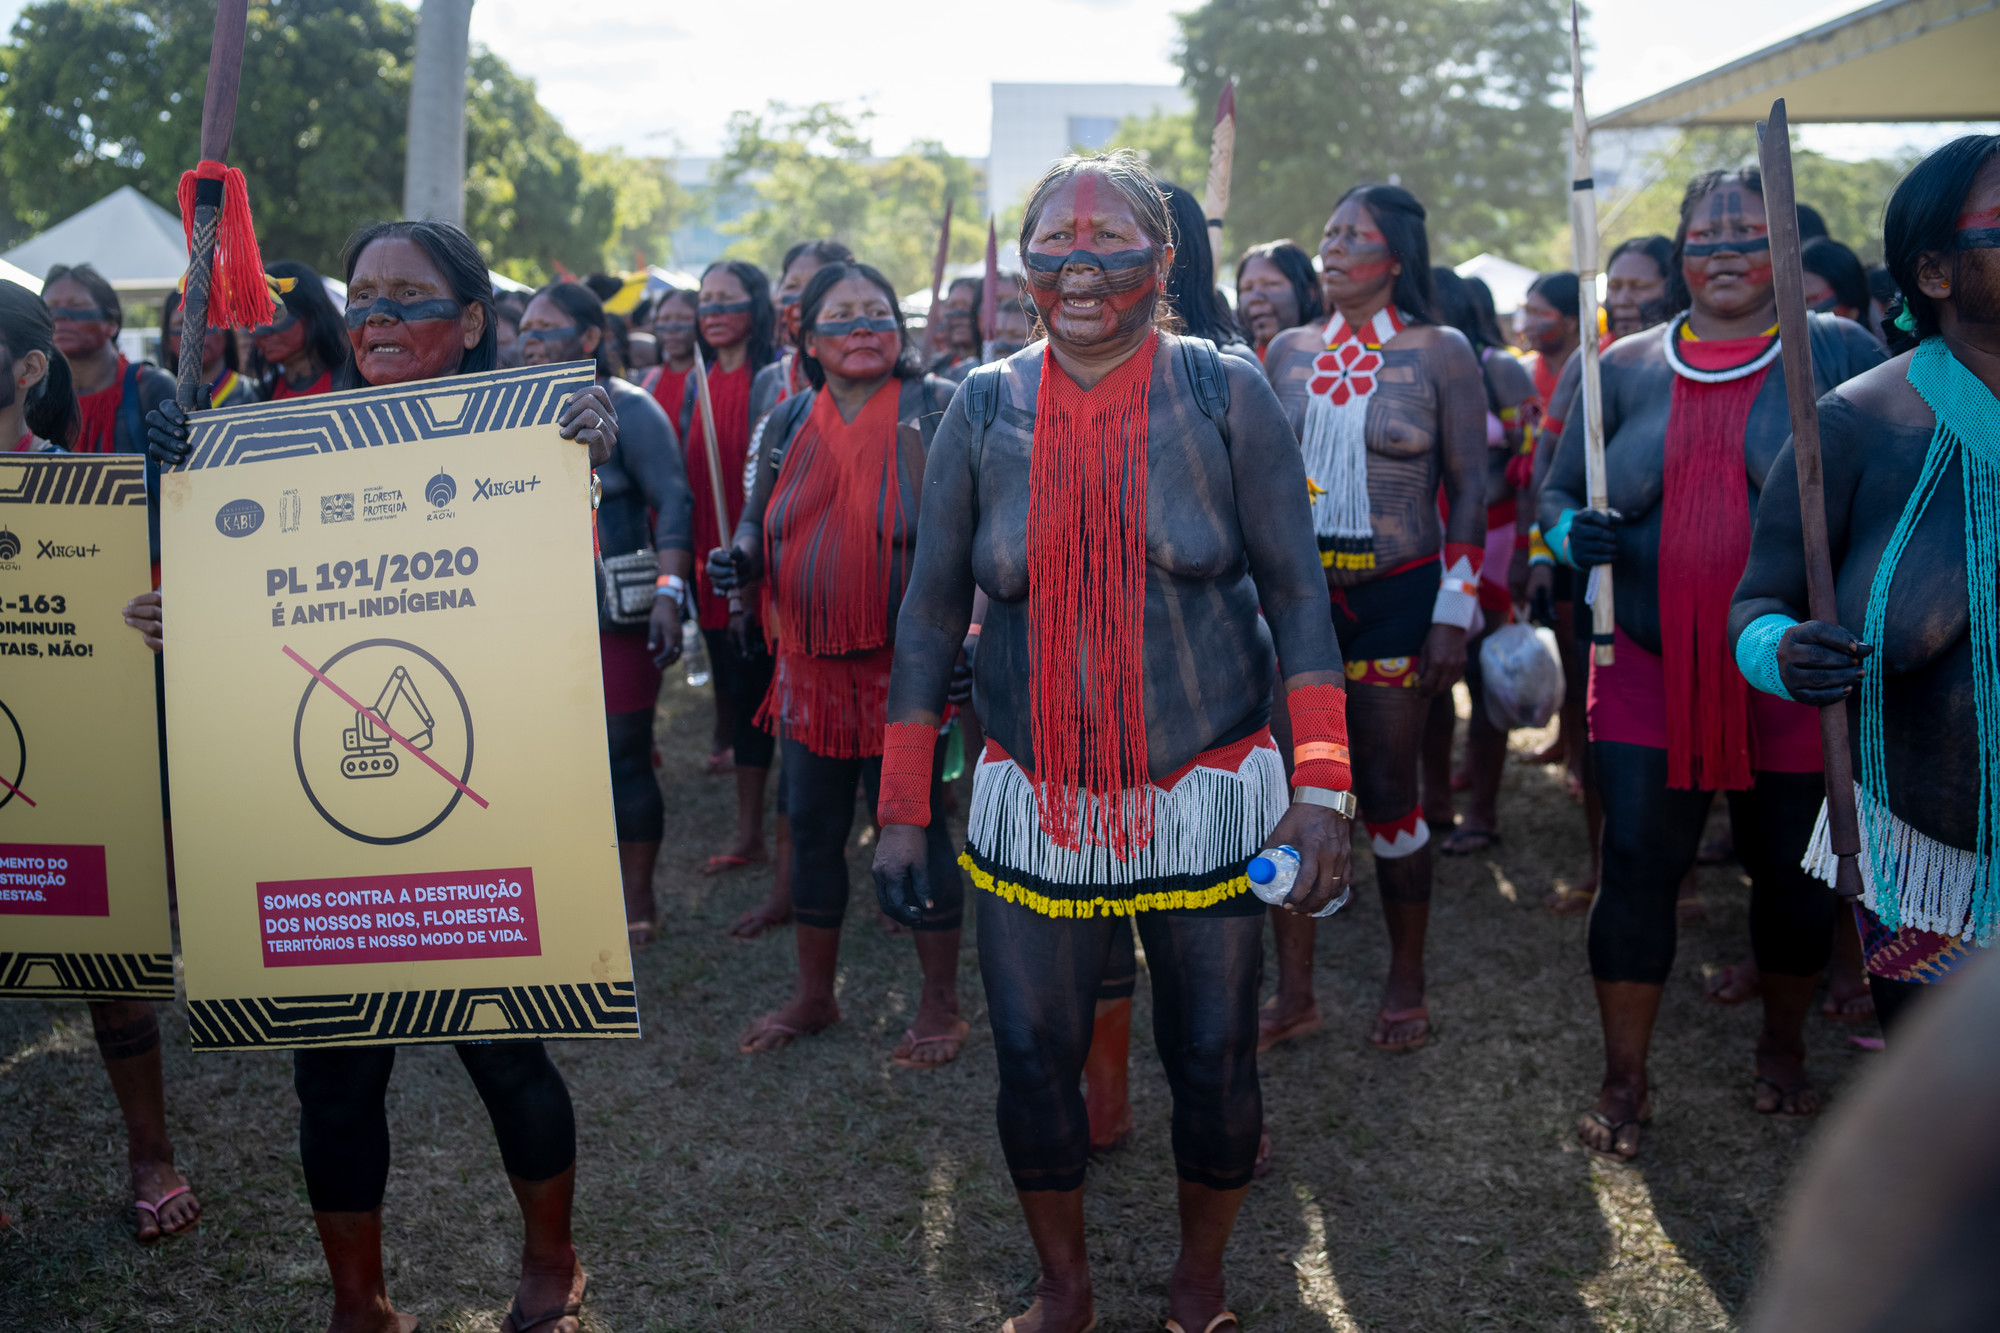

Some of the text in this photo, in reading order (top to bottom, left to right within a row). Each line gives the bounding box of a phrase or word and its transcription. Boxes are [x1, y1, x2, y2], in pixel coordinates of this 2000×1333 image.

[363, 489, 404, 504] FLORESTA
[362, 501, 407, 516] PROTEGIDA
[426, 511, 456, 521] RAONI
[223, 513, 257, 532] KABU
[266, 546, 479, 597] PL 191/2020
[0, 594, 66, 614] -163
[272, 588, 476, 627] É ANTI-INDÍGENA
[48, 640, 93, 657] NÃO!
[48, 858, 68, 870] DO
[0, 889, 47, 901] ESTAS.
[264, 879, 522, 910] SOMOS CONTRA A DESTRUIÇÃO
[265, 907, 525, 934] DOS NOSSOS RIOS, FLORESTAS,
[267, 929, 528, 953] TERRITÓRIOS E NOSSO MODO DE VIDA.
